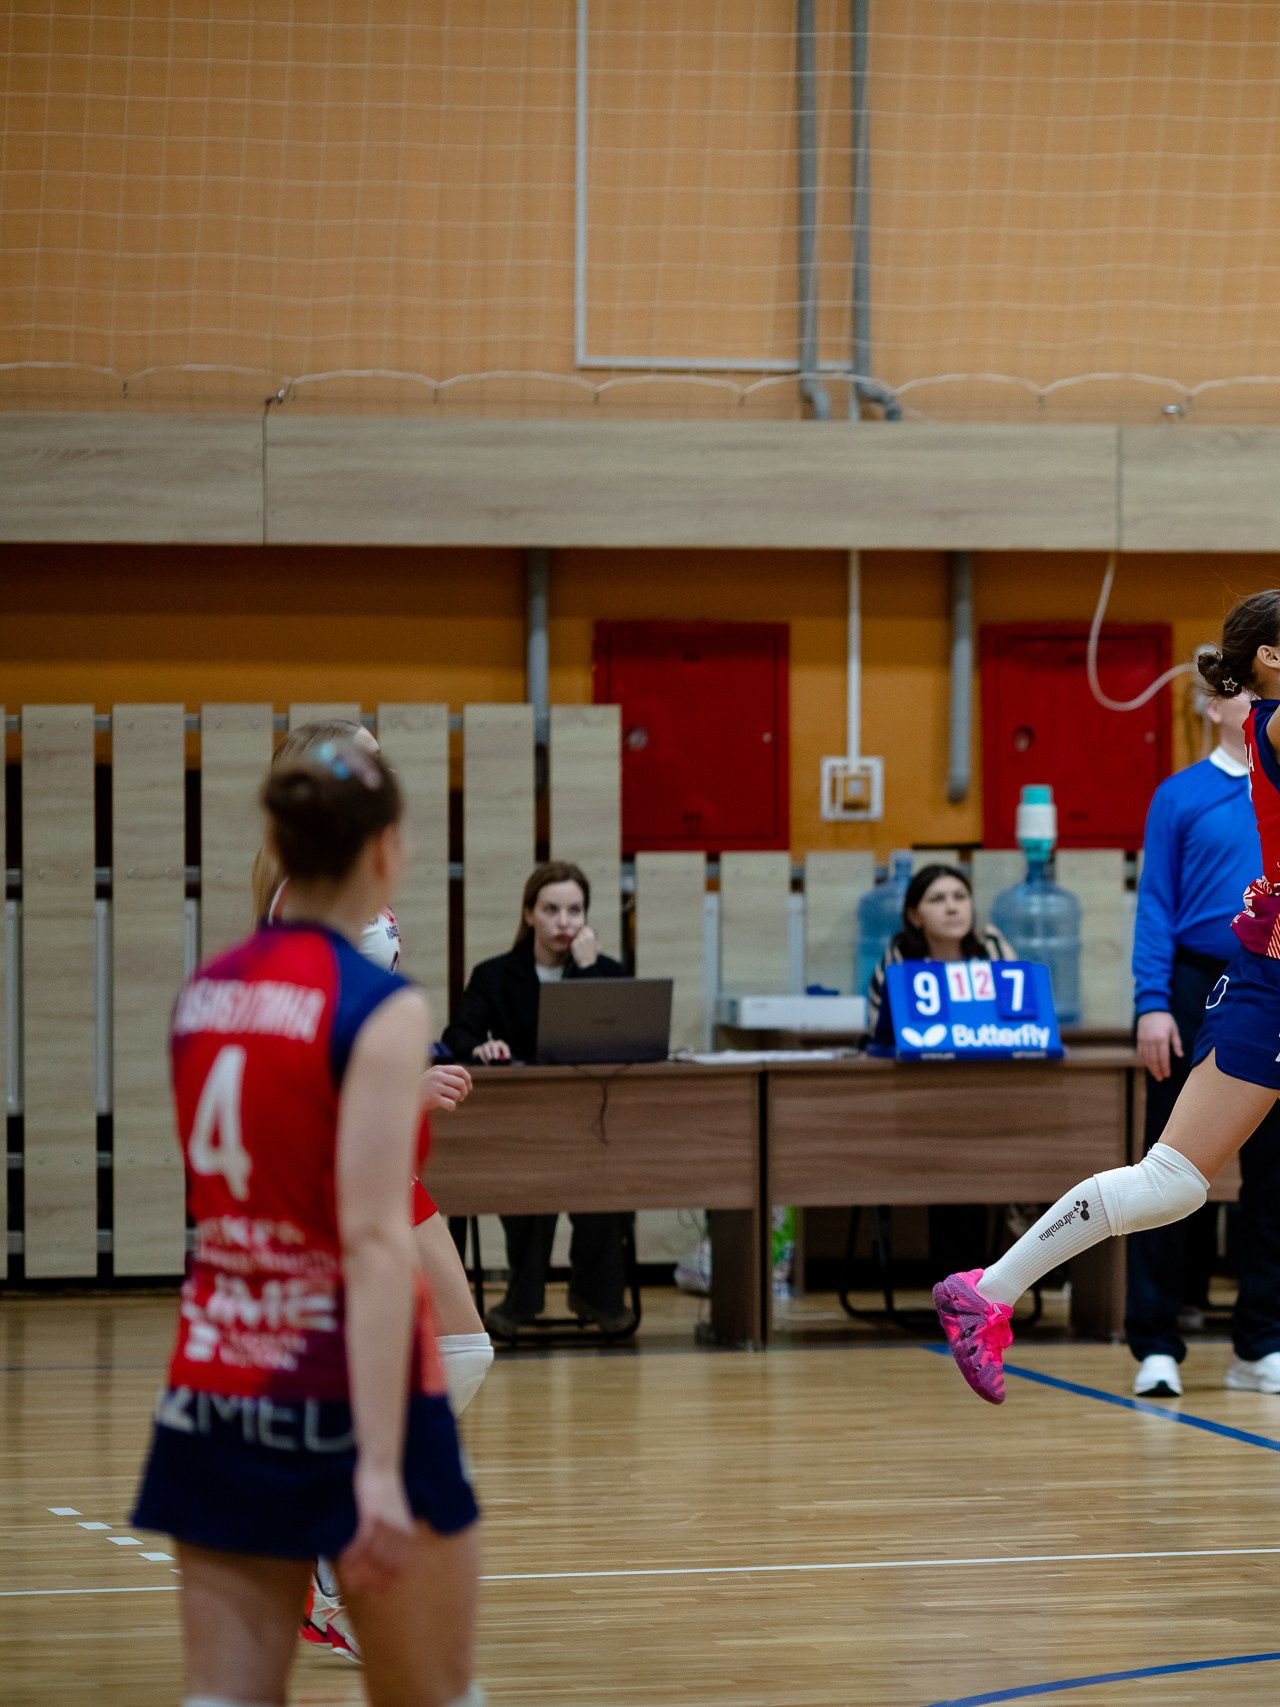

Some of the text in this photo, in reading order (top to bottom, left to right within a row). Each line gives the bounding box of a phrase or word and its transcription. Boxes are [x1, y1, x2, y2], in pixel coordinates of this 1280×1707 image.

[913, 971, 941, 1016] 9
[1001, 969, 1024, 1012] 7
[951, 1023, 1050, 1049] Butterfly
[188, 1044, 253, 1201] 4
